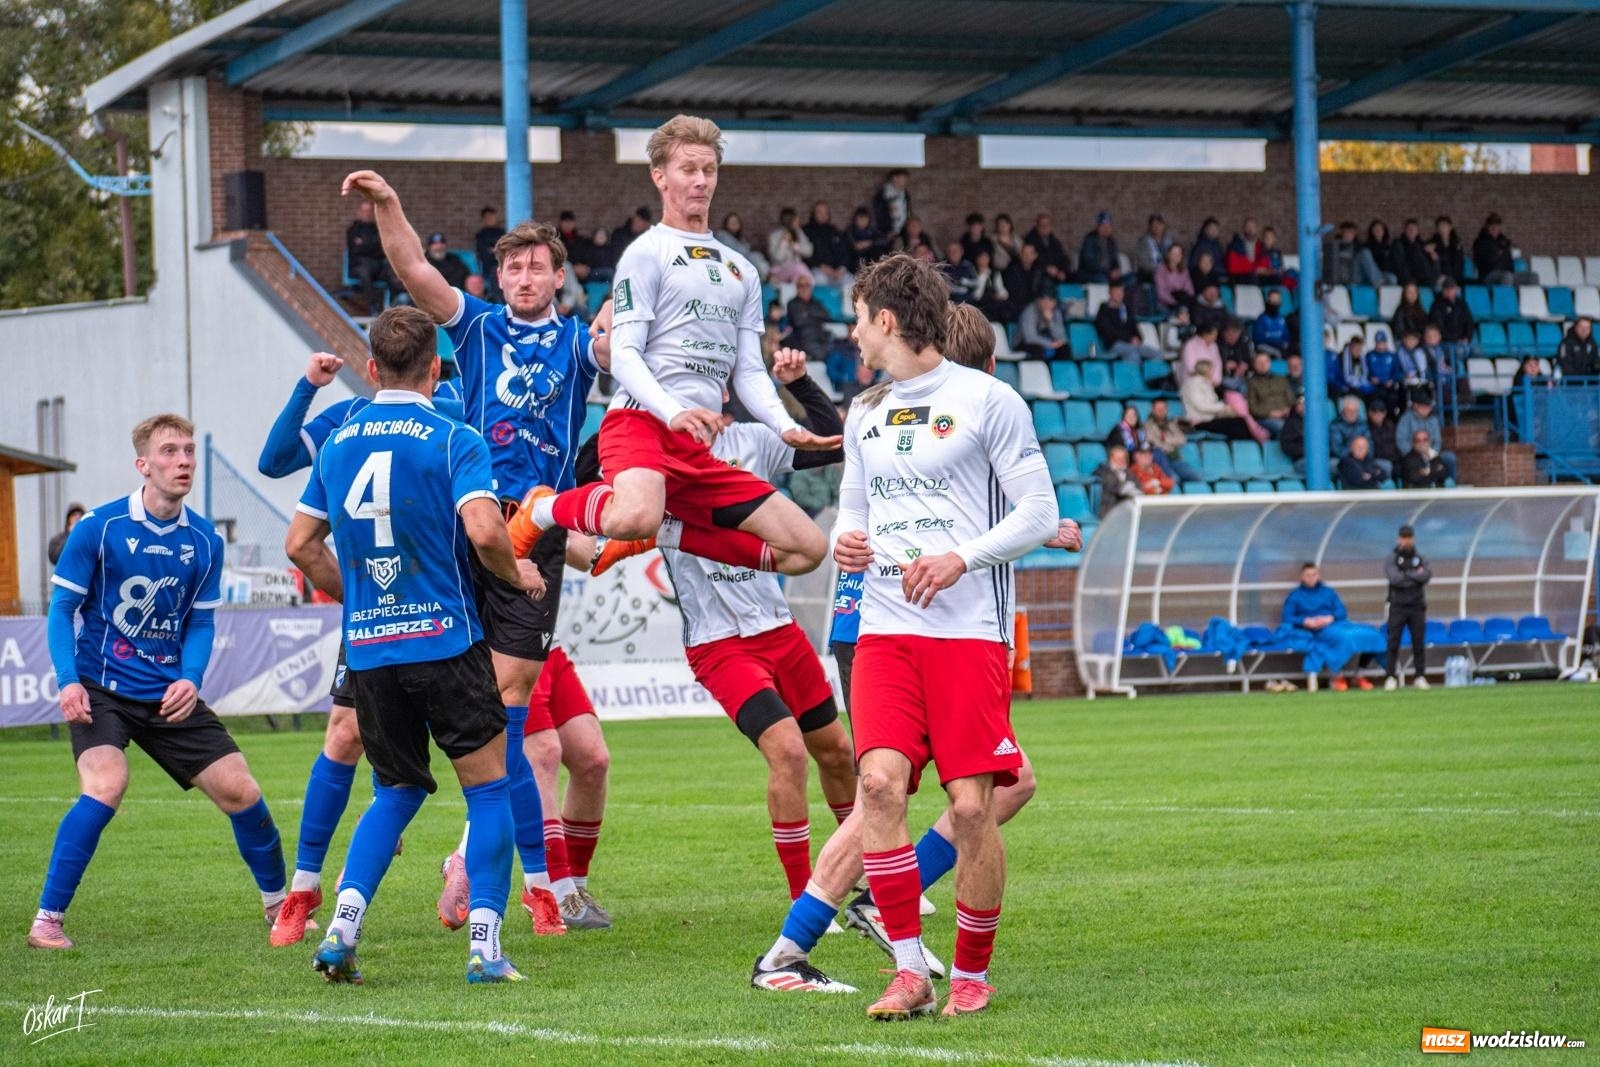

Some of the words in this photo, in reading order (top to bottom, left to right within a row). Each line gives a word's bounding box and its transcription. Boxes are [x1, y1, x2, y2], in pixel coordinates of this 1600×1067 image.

[334, 423, 360, 445] UNIA
[362, 418, 435, 441] RACIBÓRZ
[343, 450, 395, 547] 4
[870, 476, 950, 500] REKPOL
[876, 520, 909, 536] SACHS
[915, 518, 954, 530] TRANS
[378, 593, 396, 606] MB
